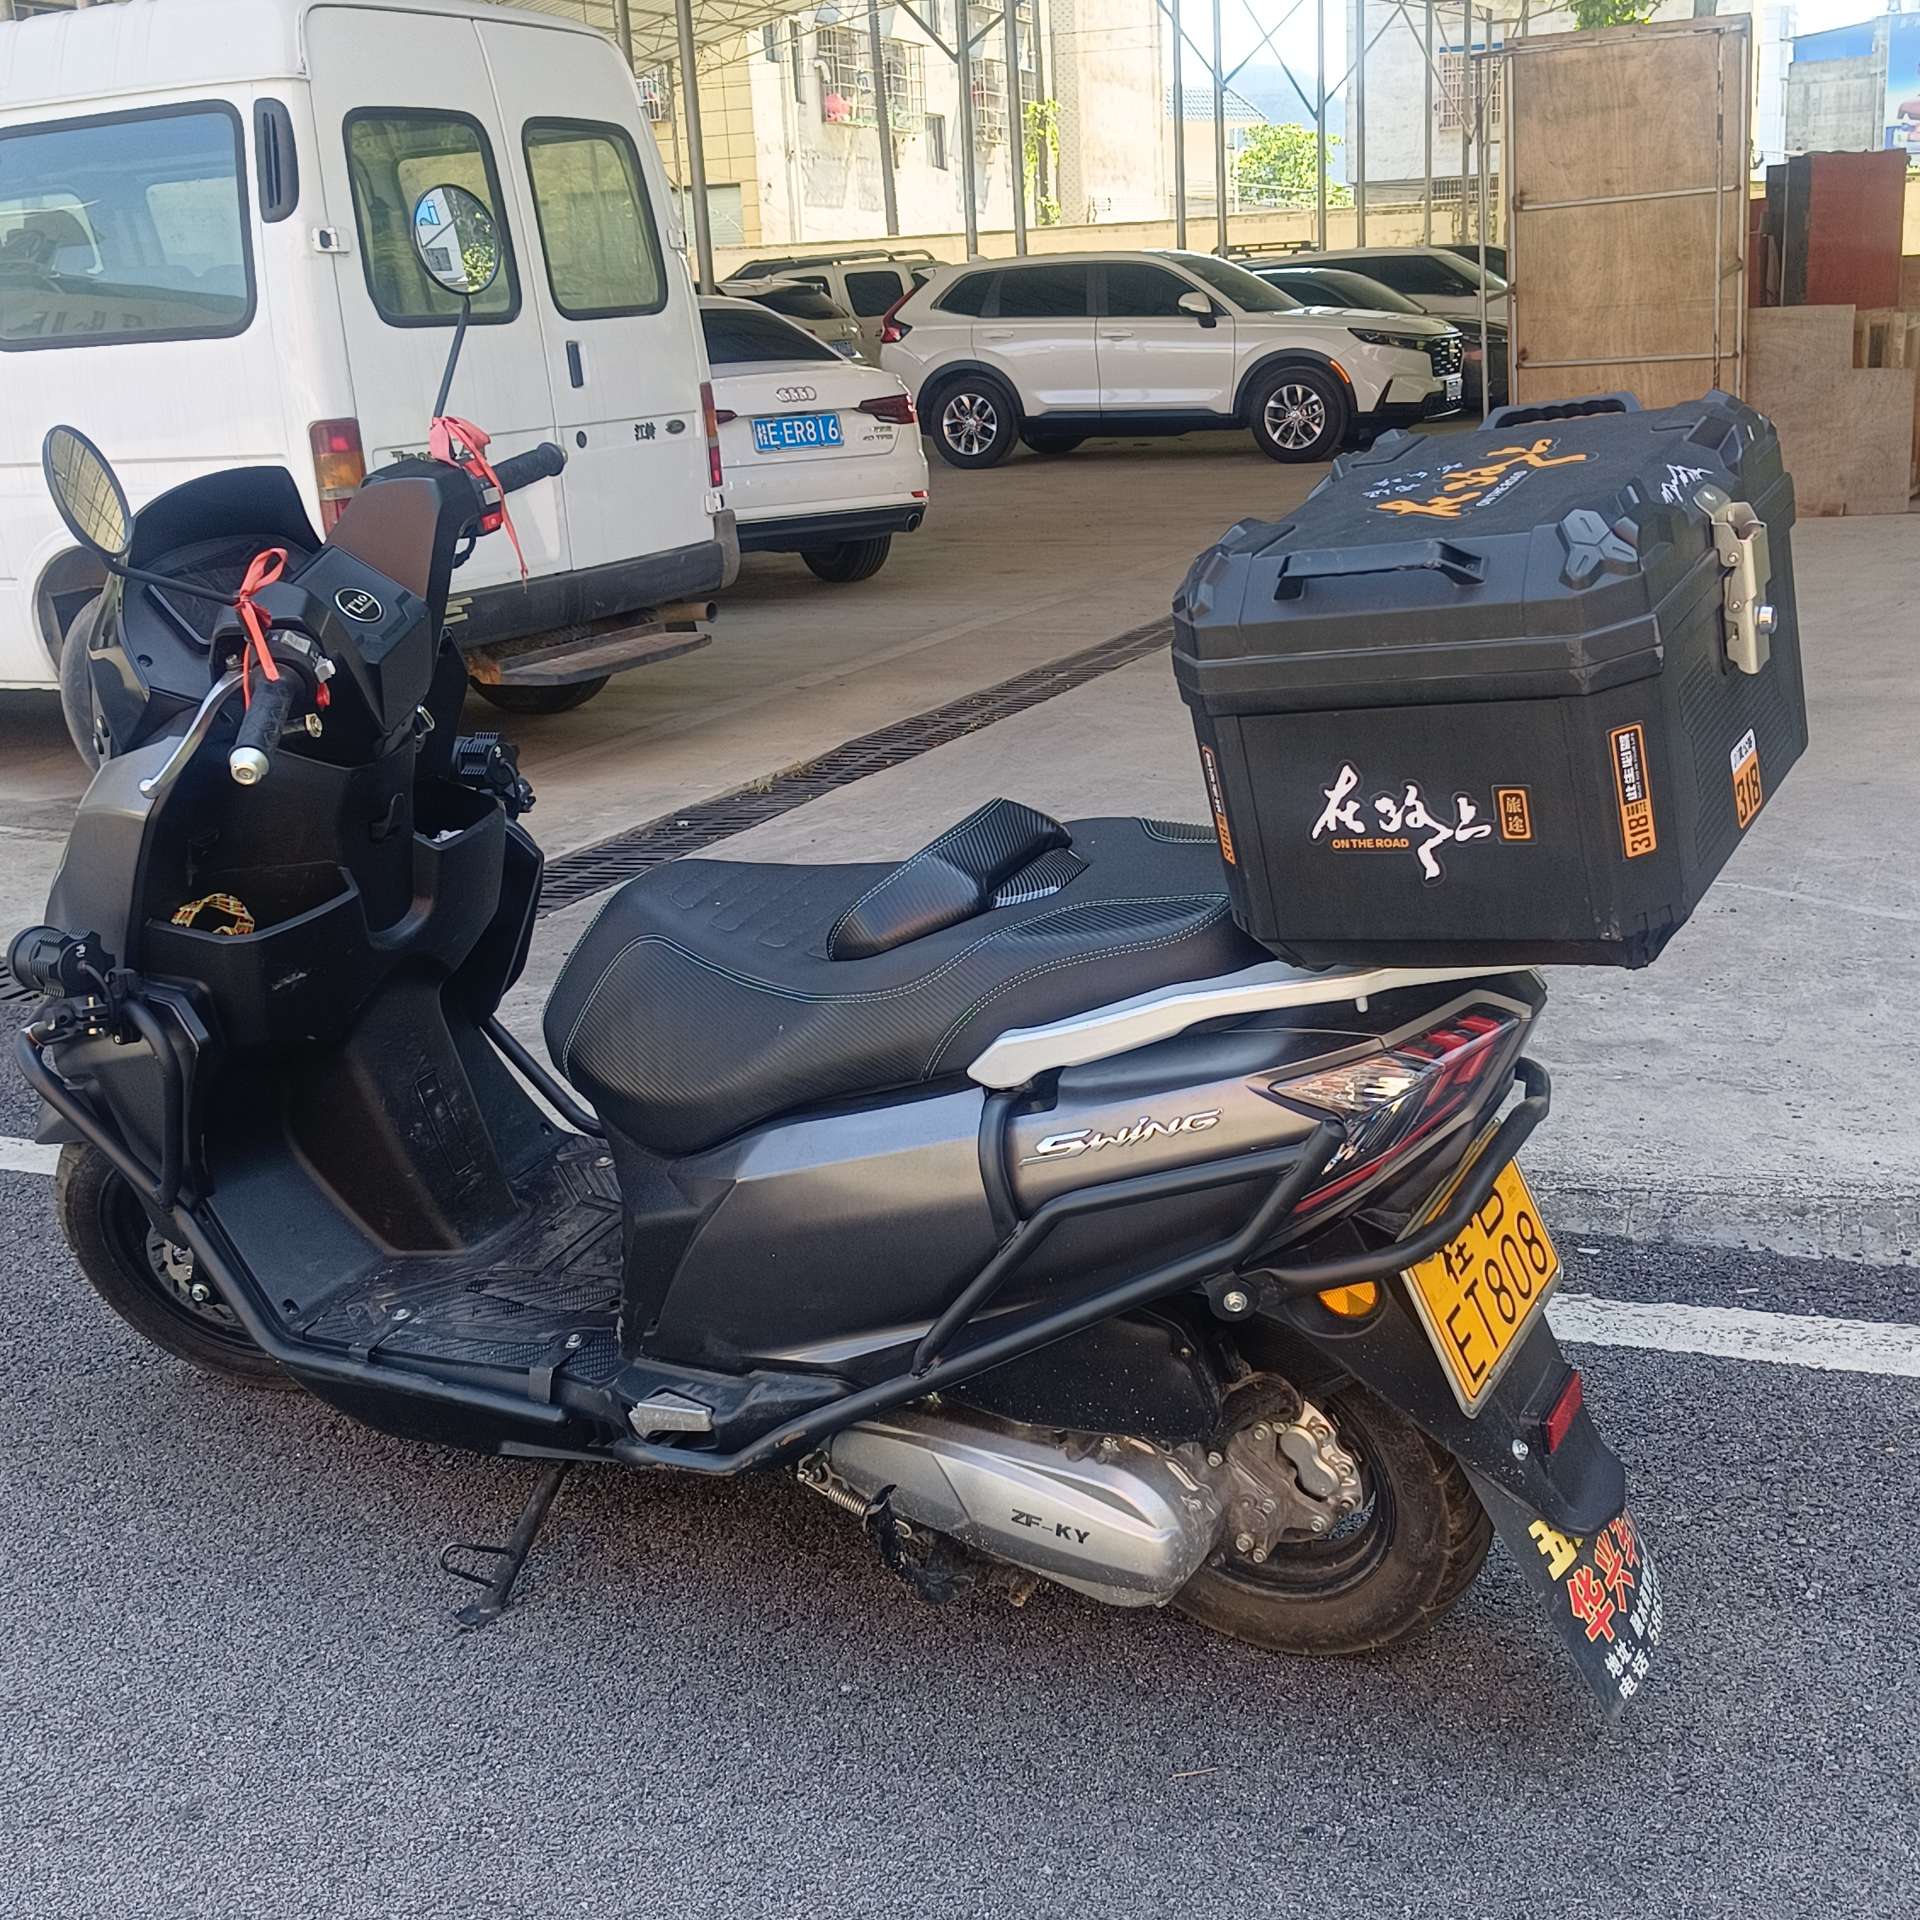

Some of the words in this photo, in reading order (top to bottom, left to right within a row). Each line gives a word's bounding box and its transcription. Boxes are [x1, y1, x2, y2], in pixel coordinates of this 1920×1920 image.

[1735, 762, 1761, 823] 318
[1332, 838, 1351, 849] ON
[1351, 838, 1374, 849] THE
[1375, 838, 1409, 849] ROAD
[1628, 814, 1651, 852] 318
[1445, 1210, 1548, 1383] ET808
[1011, 1508, 1090, 1545] ZF-KY
